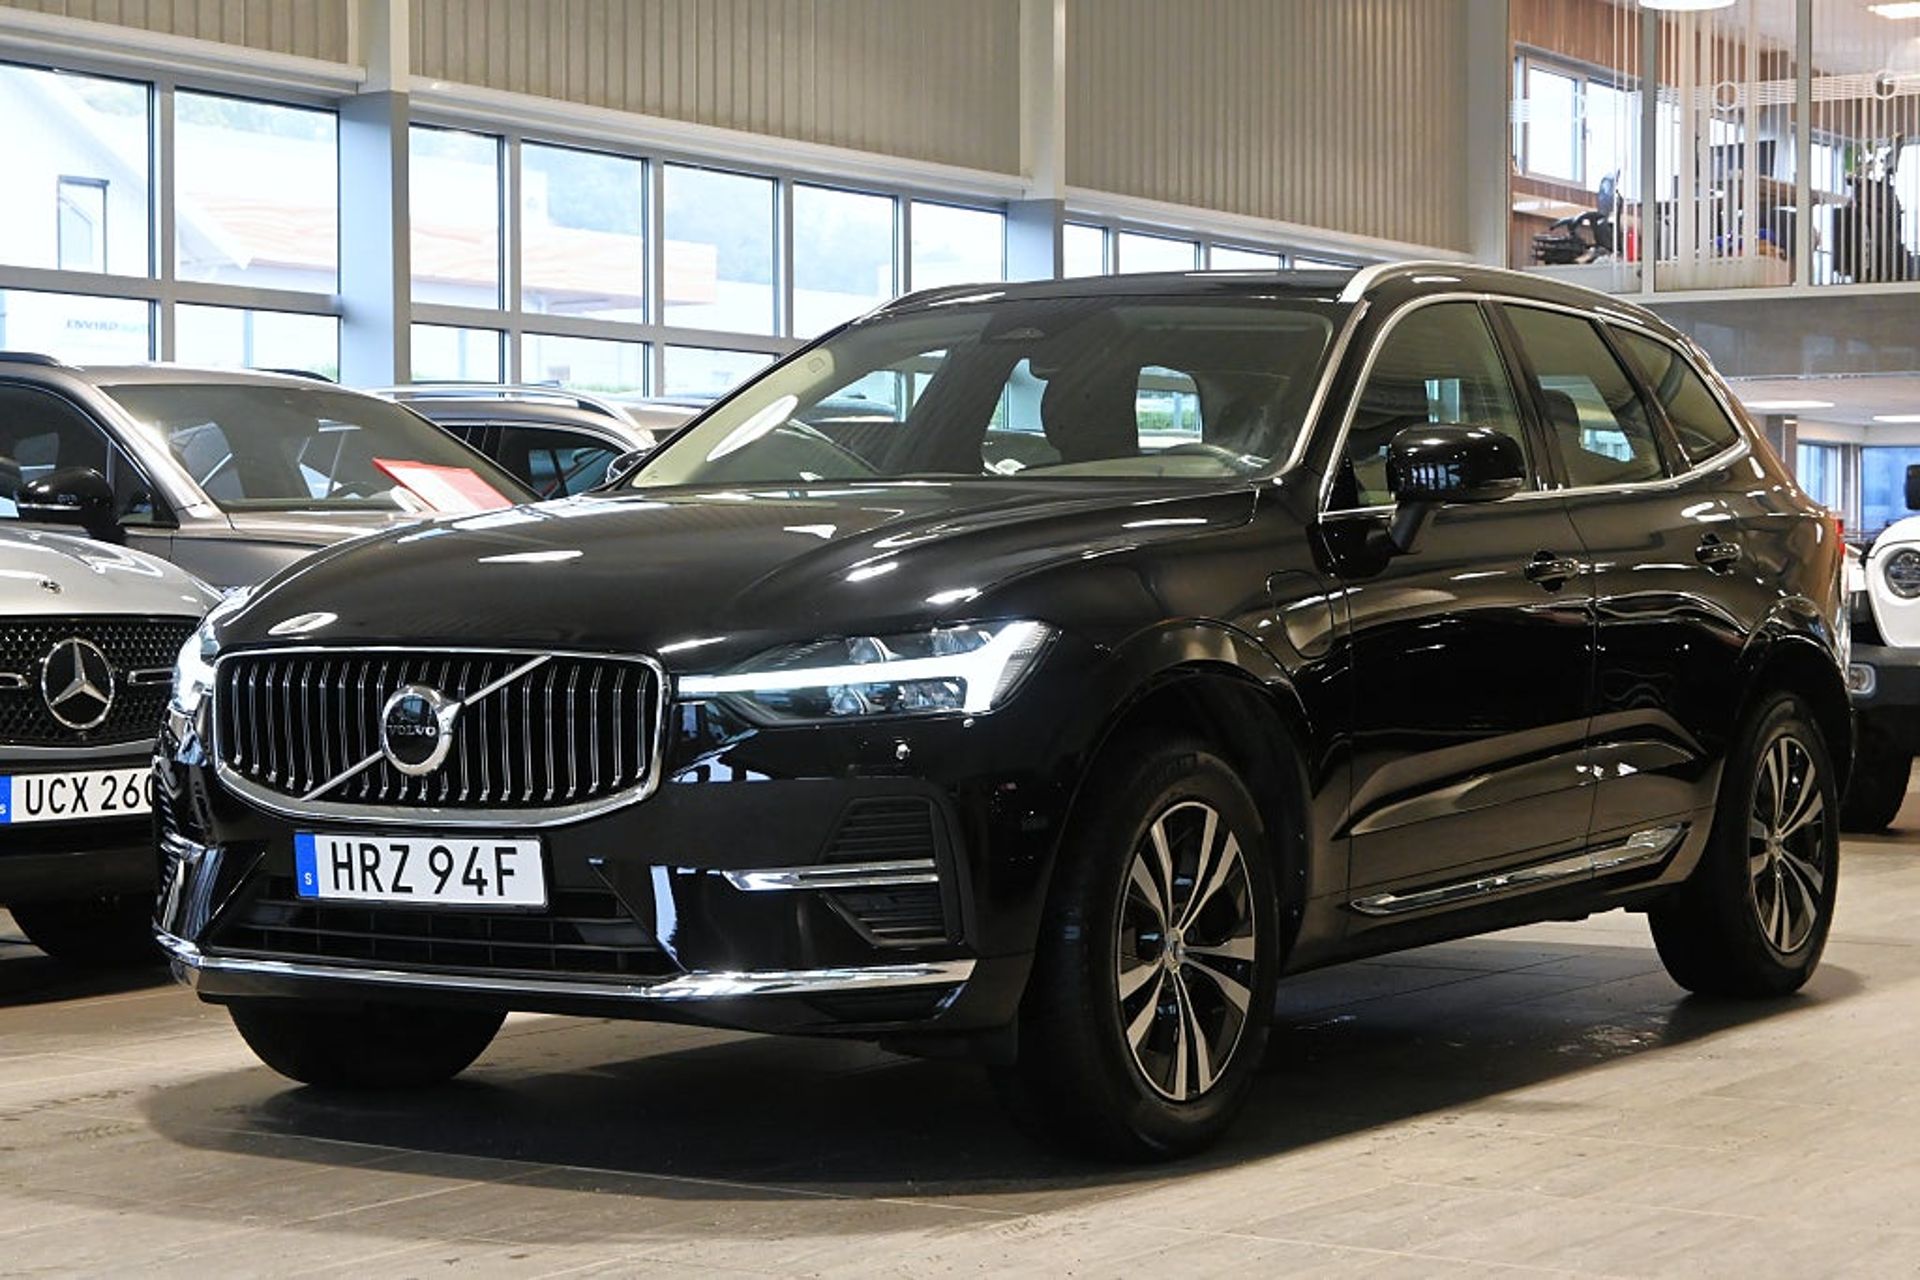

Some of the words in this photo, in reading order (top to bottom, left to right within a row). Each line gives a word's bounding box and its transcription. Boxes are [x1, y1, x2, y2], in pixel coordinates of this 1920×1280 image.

[386, 724, 436, 736] VOLVO
[25, 776, 89, 815] UCX
[304, 872, 312, 885] S
[331, 841, 413, 893] HRZ
[428, 845, 518, 896] 94F
